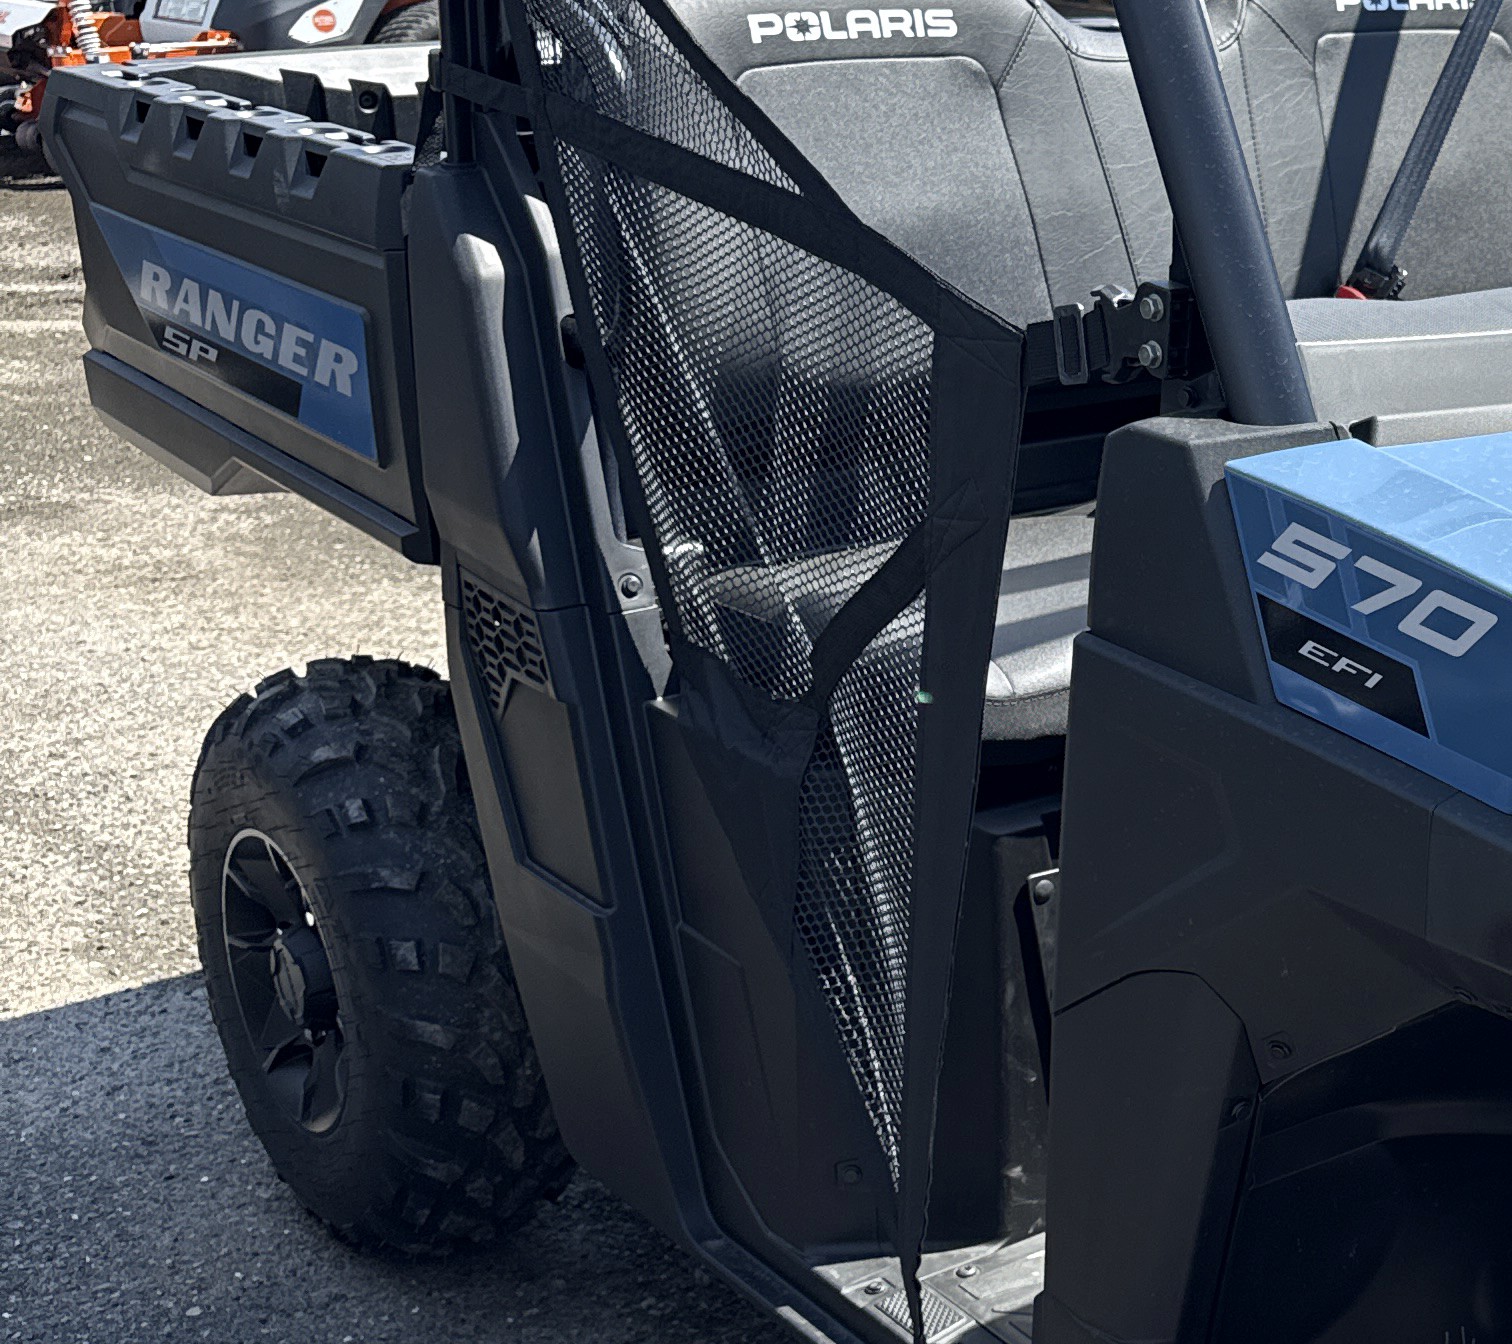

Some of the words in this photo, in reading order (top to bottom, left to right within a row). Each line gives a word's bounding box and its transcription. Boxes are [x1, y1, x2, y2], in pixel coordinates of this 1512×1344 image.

[747, 8, 958, 44] POLARIS
[140, 259, 359, 398] RANGER
[162, 325, 219, 363] SP
[1256, 521, 1499, 658] 570
[1298, 639, 1384, 689] EFI
